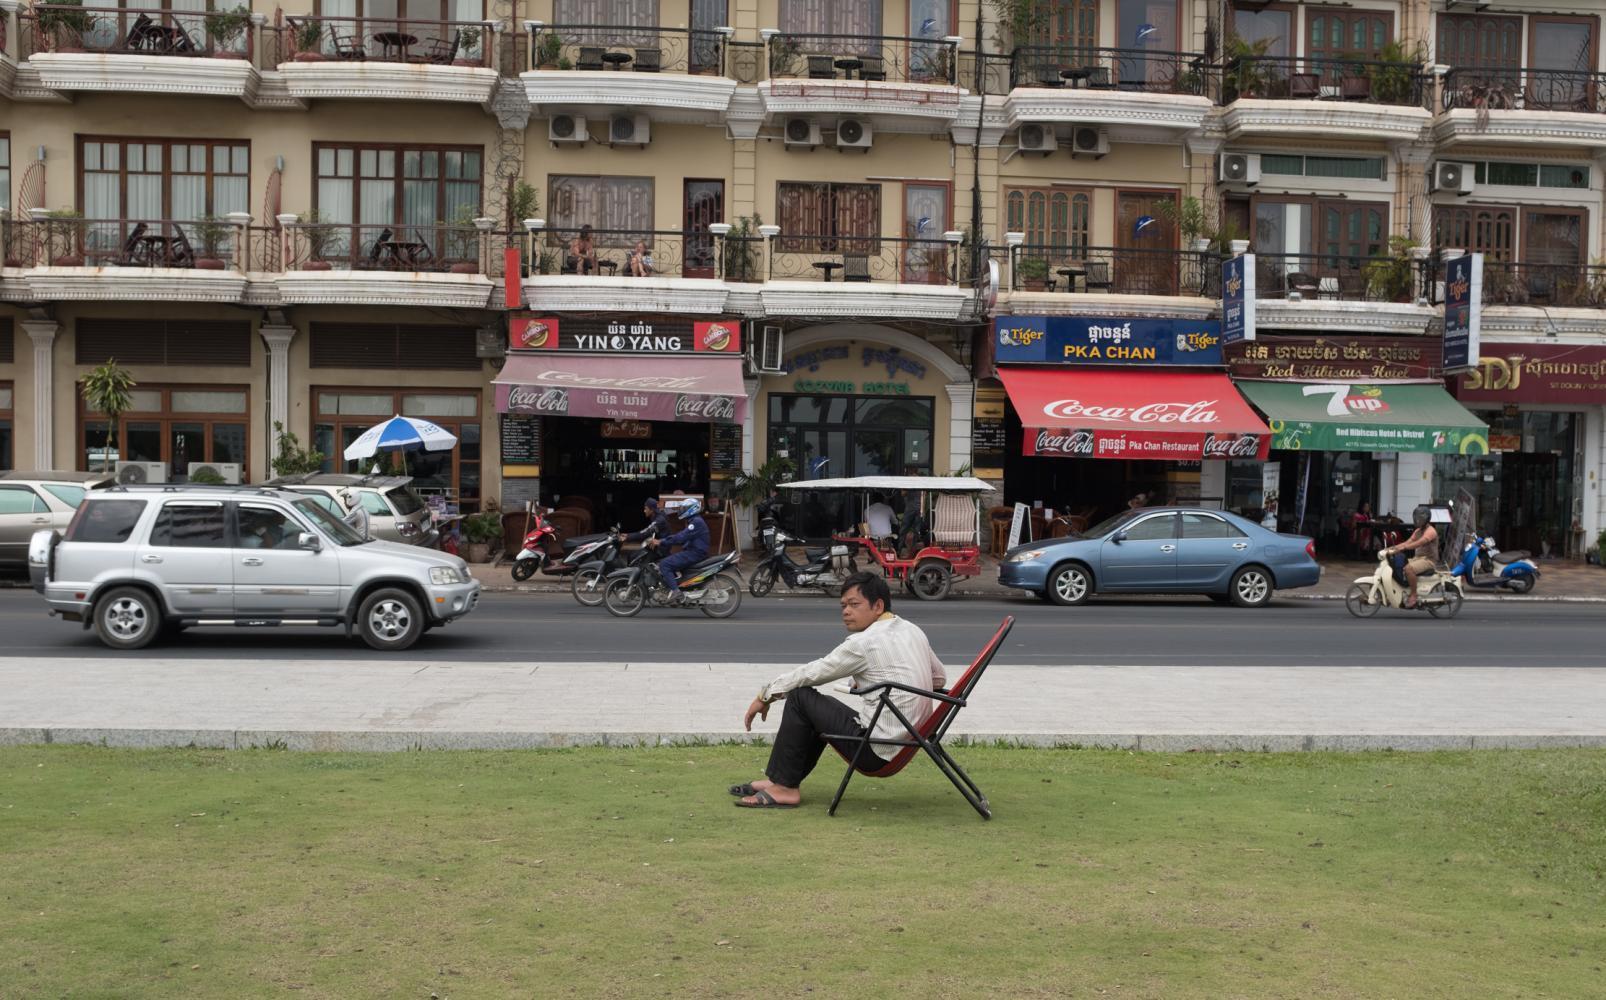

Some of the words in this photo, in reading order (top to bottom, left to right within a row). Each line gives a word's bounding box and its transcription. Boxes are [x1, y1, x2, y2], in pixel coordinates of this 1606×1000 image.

[1449, 280, 1469, 301] Tiger
[574, 335, 607, 349] YIN
[628, 336, 681, 351] YANG
[1011, 327, 1044, 345] Tiger
[1187, 332, 1219, 350] Tiger
[1063, 345, 1101, 358] PKA
[1105, 346, 1156, 360] CHAN
[1262, 364, 1295, 378] Red
[1299, 365, 1361, 380] Hibiscus
[1369, 365, 1409, 380] Hotel
[508, 386, 568, 411] Coca-Cola
[675, 395, 735, 419] Coca-Cola
[606, 408, 619, 417] Yin
[620, 409, 638, 418] Yang
[1043, 399, 1219, 424] Coca-Cola
[1335, 428, 1349, 436] Red
[1035, 431, 1094, 454] Coca-Cola
[1128, 442, 1142, 451] Pka
[1143, 442, 1161, 451] Chan
[1162, 442, 1200, 452] Restaurant
[1203, 435, 1259, 457] Coca-Cola
